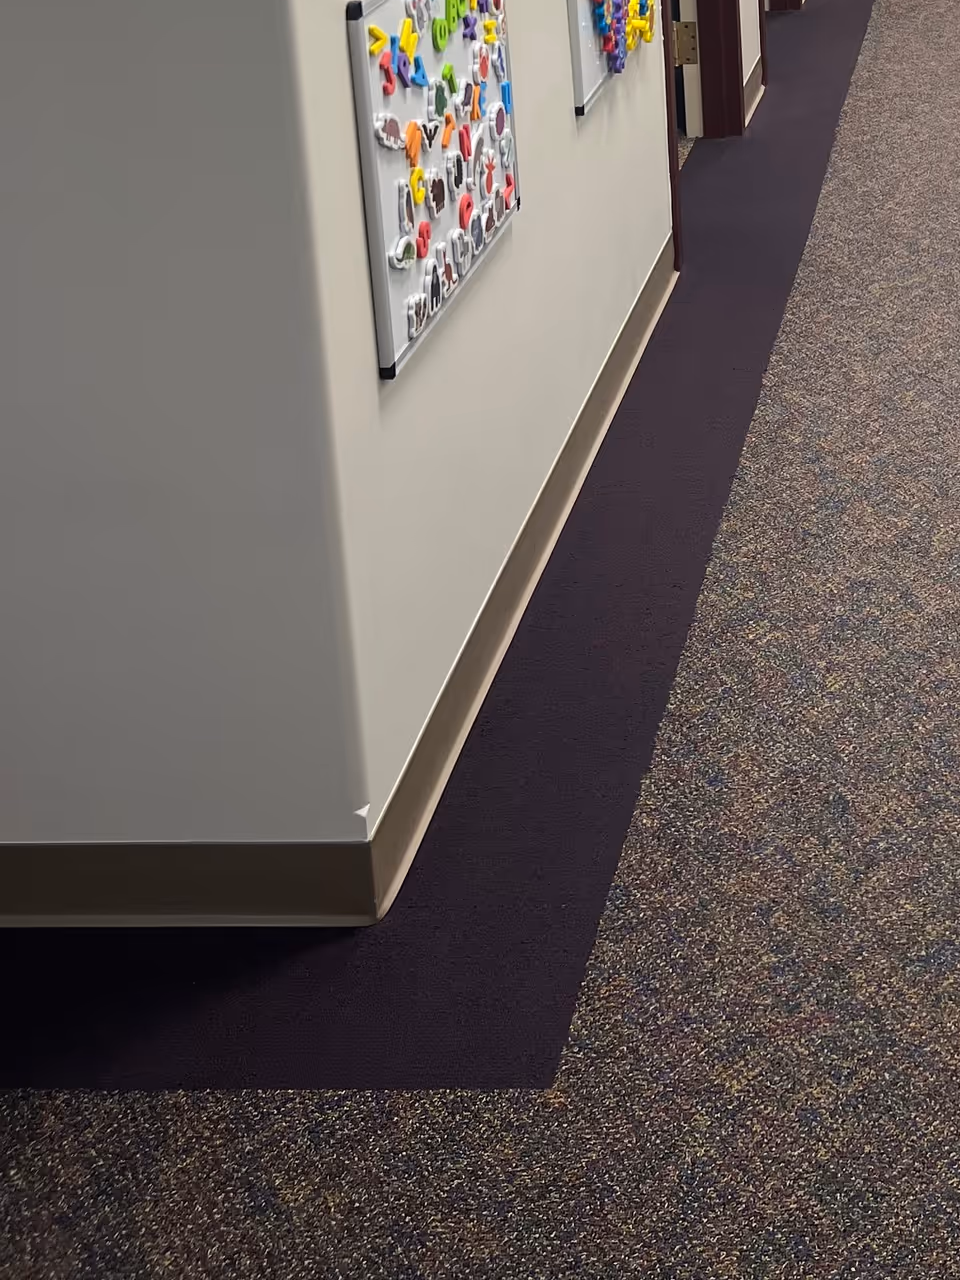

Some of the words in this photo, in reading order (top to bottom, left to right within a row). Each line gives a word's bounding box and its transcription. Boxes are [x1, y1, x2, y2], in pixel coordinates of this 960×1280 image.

[463, 14, 477, 40] X
[471, 85, 481, 120] K
[411, 167, 425, 205] C
